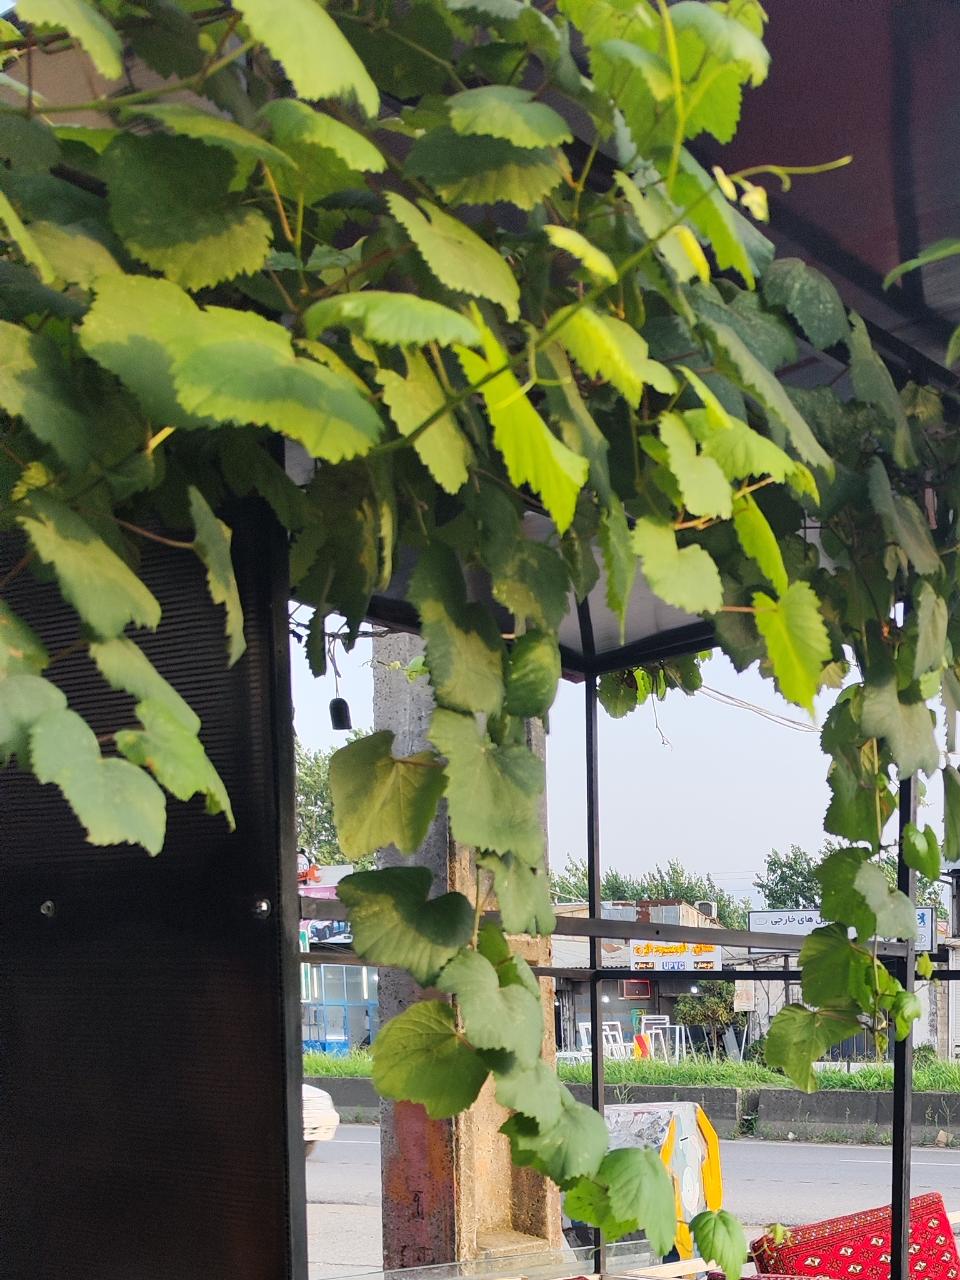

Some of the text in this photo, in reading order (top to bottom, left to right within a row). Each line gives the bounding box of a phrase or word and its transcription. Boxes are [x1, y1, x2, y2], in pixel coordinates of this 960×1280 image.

[770, 915, 796, 926] خارجی
[797, 916, 814, 925] های
[663, 961, 686, 969] UPVC
